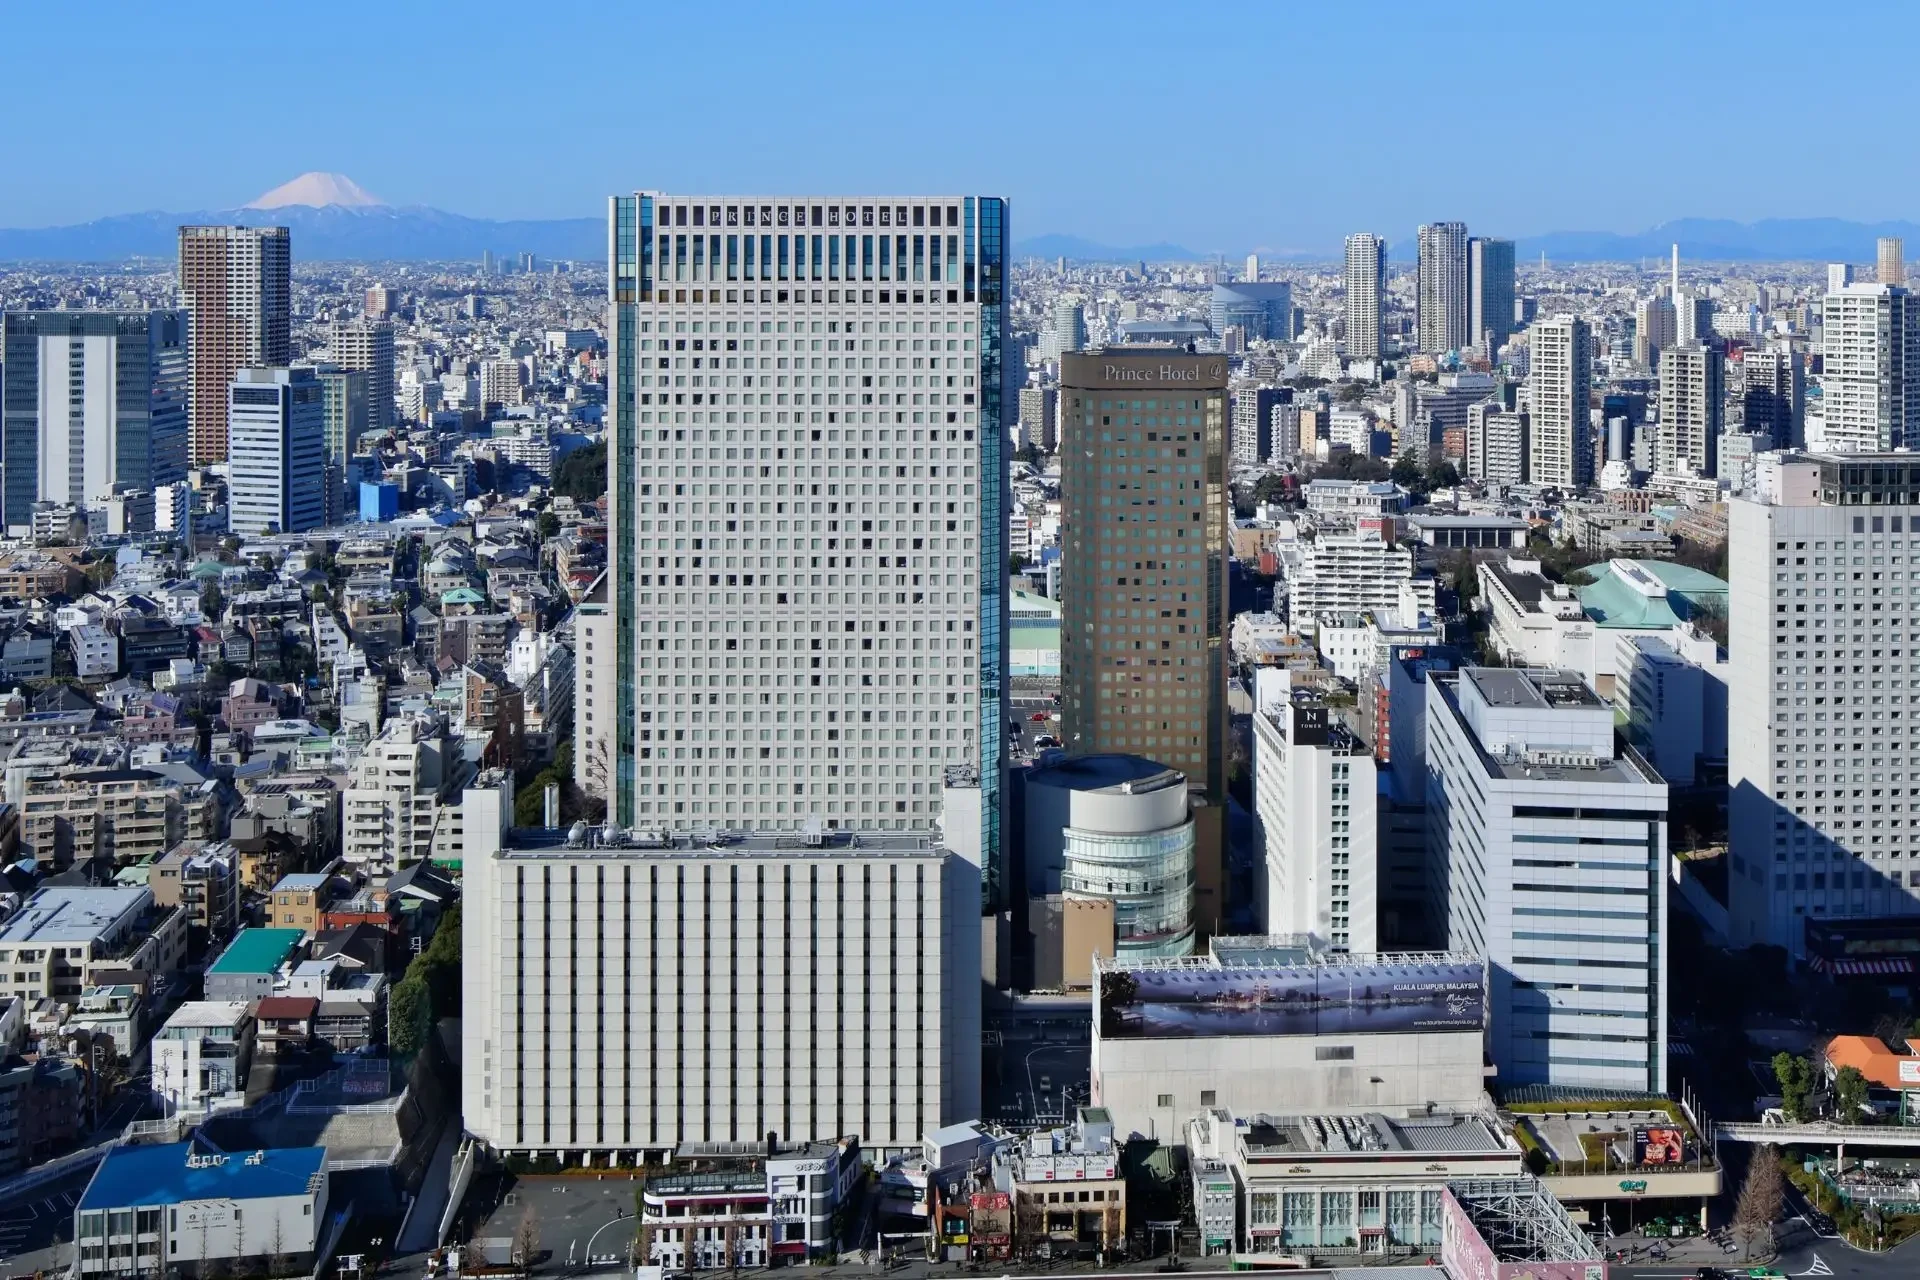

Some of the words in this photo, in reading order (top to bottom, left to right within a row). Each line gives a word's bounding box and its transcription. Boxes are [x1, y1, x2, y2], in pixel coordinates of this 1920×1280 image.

[711, 212, 804, 222] PRINCE
[829, 212, 907, 222] HOTEL
[1104, 365, 1153, 381] Prince
[1159, 364, 1199, 381] Hotel
[1306, 710, 1317, 721] N
[1416, 983, 1446, 991] LUMPUR,
[1446, 982, 1479, 990] MALAYSIA
